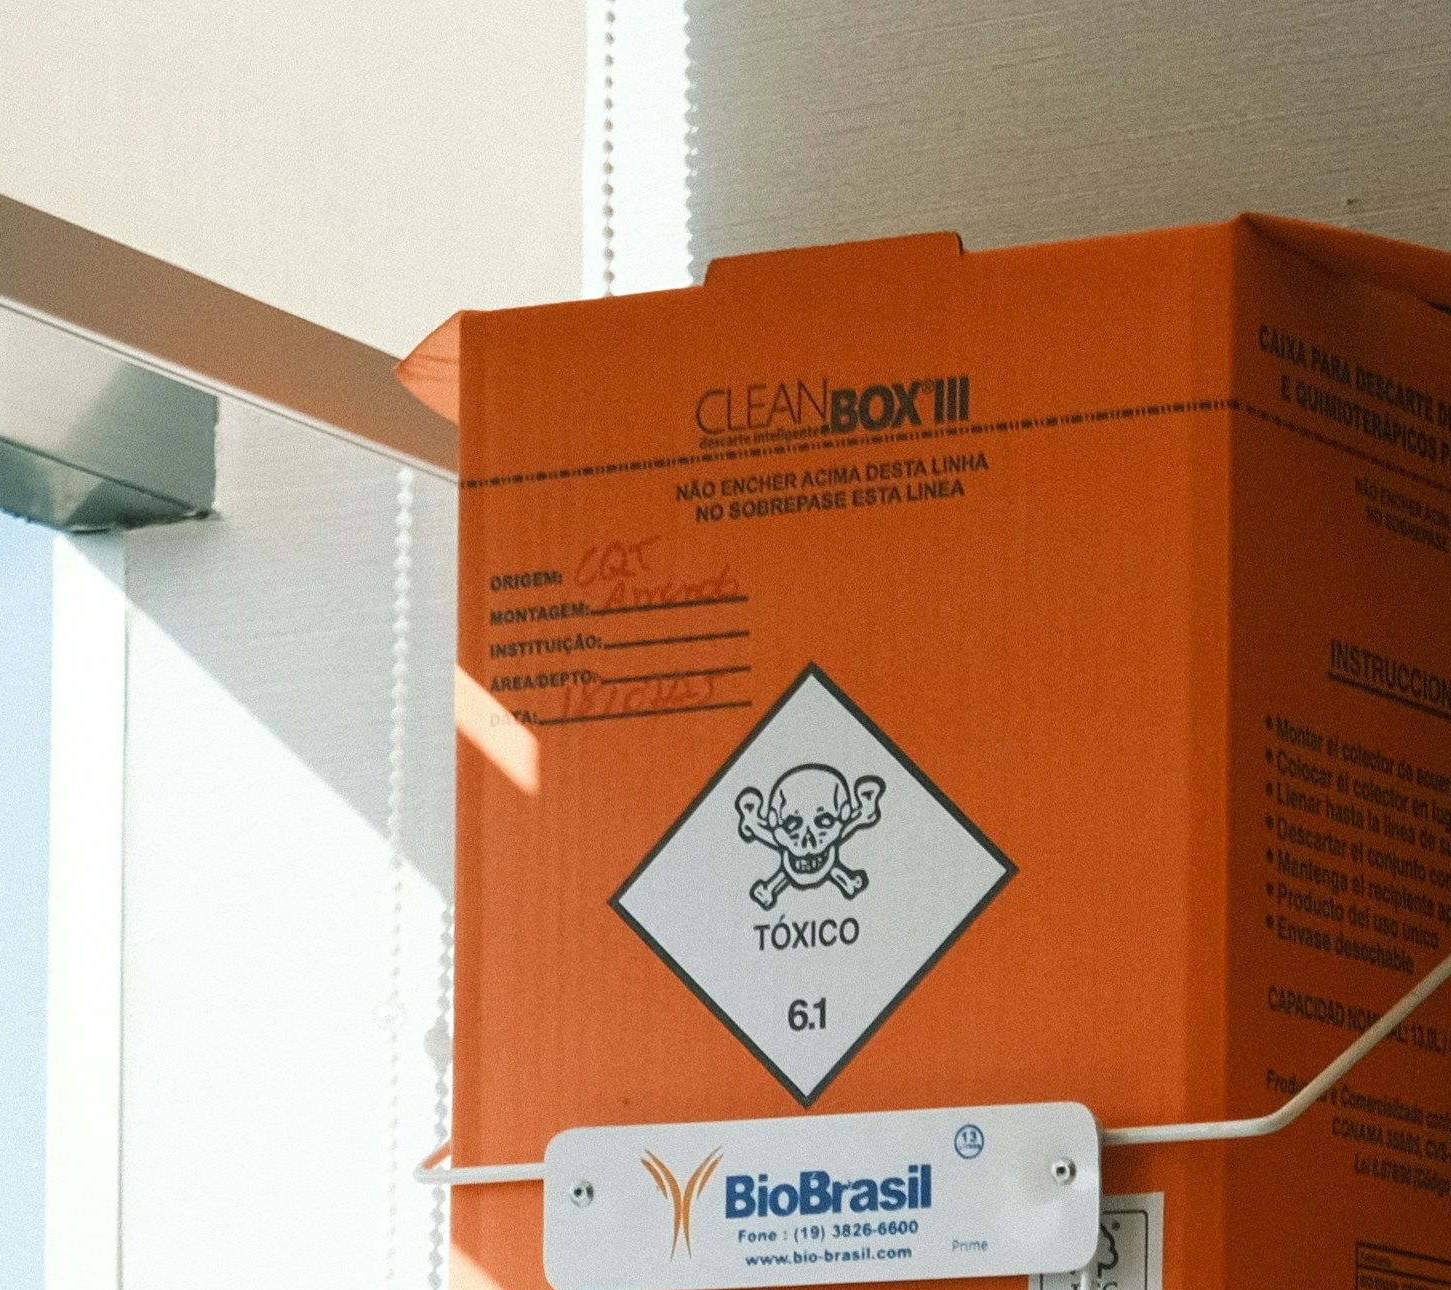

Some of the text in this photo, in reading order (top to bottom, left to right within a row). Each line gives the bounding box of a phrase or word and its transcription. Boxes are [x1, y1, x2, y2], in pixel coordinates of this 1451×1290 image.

[1259, 323, 1309, 369] CAIXA
[1311, 347, 1351, 389] PARA
[1355, 365, 1435, 423] DESCARTE
[1281, 373, 1291, 404] E
[676, 450, 989, 503] NÃO ENCHER ACIMA DESTA LINHA
[696, 478, 966, 523] NO SOBREPASE ESTA LINEA
[489, 570, 563, 594] ORIGEM:
[489, 601, 591, 626] MONTAGEM:
[489, 631, 602, 660] INSTITUIÇÃO:
[753, 914, 860, 951] TÓXICO
[788, 997, 827, 1032] 6.1
[1268, 986, 1345, 1028] CAPACIDAD
[961, 1130, 978, 1143] 13
[725, 1163, 933, 1219] BioBrasil
[738, 1219, 919, 1243] Fone (19) 3826-6600
[951, 1238, 989, 1252] Prime
[745, 1245, 913, 1267] www.bio-brasil.com
